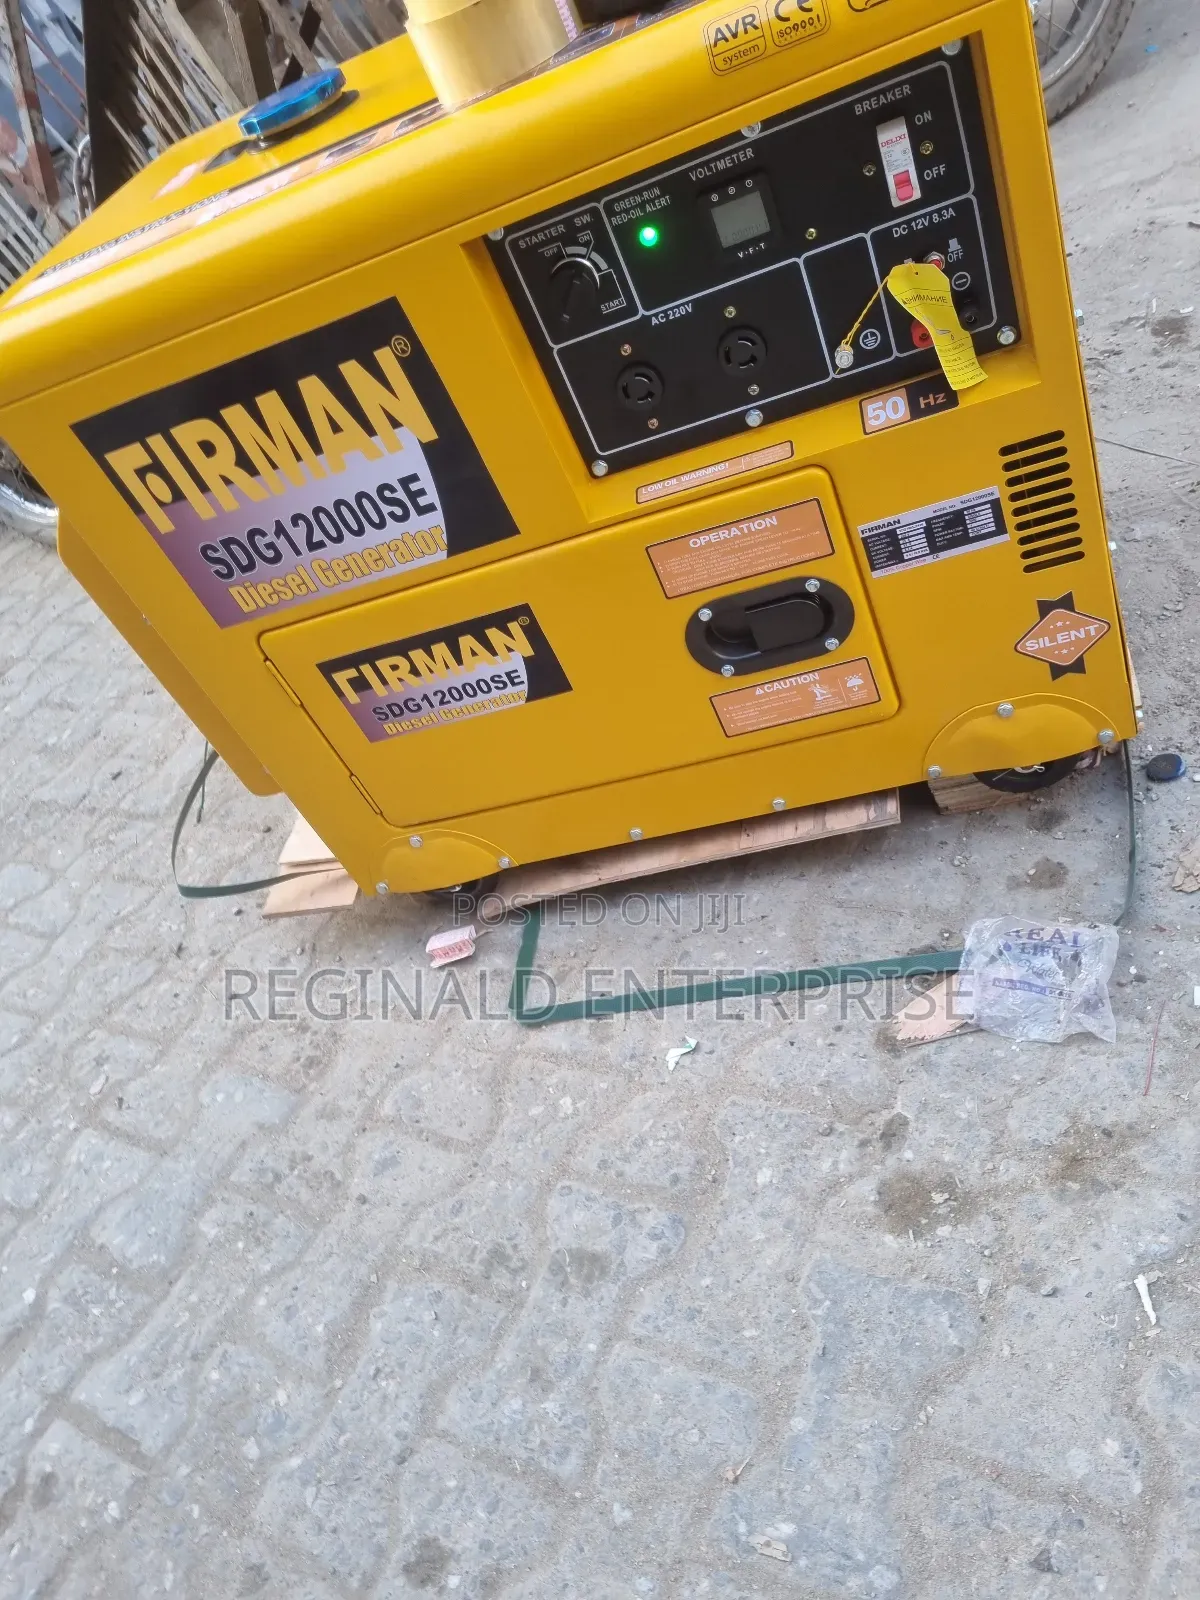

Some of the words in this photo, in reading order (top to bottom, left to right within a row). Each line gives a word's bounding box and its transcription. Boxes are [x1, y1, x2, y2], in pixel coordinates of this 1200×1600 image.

[713, 13, 760, 48] AVR
[722, 43, 760, 66] system
[854, 84, 912, 115] BREAKER
[914, 110, 933, 125] ON
[880, 133, 907, 148] DELIXI
[689, 148, 755, 182] VOLTMETER
[923, 164, 946, 181] OFF
[611, 209, 644, 227] RED-OIL
[646, 195, 672, 213] ALERT
[614, 187, 661, 212] GREEN-RUN
[518, 224, 566, 249] STARTER
[574, 213, 594, 227] SW.
[892, 224, 909, 238] DC
[911, 215, 930, 232] 12V
[932, 207, 956, 224] 8.3A
[544, 247, 559, 258] OFF
[578, 234, 591, 244] ON
[947, 249, 964, 263] OFF
[600, 298, 624, 312] START
[651, 313, 666, 326] AC
[668, 303, 693, 320] 220V
[867, 396, 906, 426] 50
[919, 392, 947, 409] Hz
[104, 346, 440, 535] FIRMAN
[642, 483, 664, 495] LOW
[665, 478, 680, 487] OIL
[681, 462, 729, 482] WARNING!
[199, 472, 439, 581] SDG12000SE
[689, 516, 778, 549] OPERATION
[861, 518, 901, 536] FIRMAN
[228, 564, 315, 614] Diesel
[309, 524, 450, 588] Generator
[1025, 624, 1100, 651] SILENT
[331, 620, 535, 705] FIRMAN
[371, 669, 526, 722] SDG12000SE
[764, 672, 820, 693] CAUTION
[382, 714, 439, 737] Diesel
[439, 690, 528, 722] Generator
